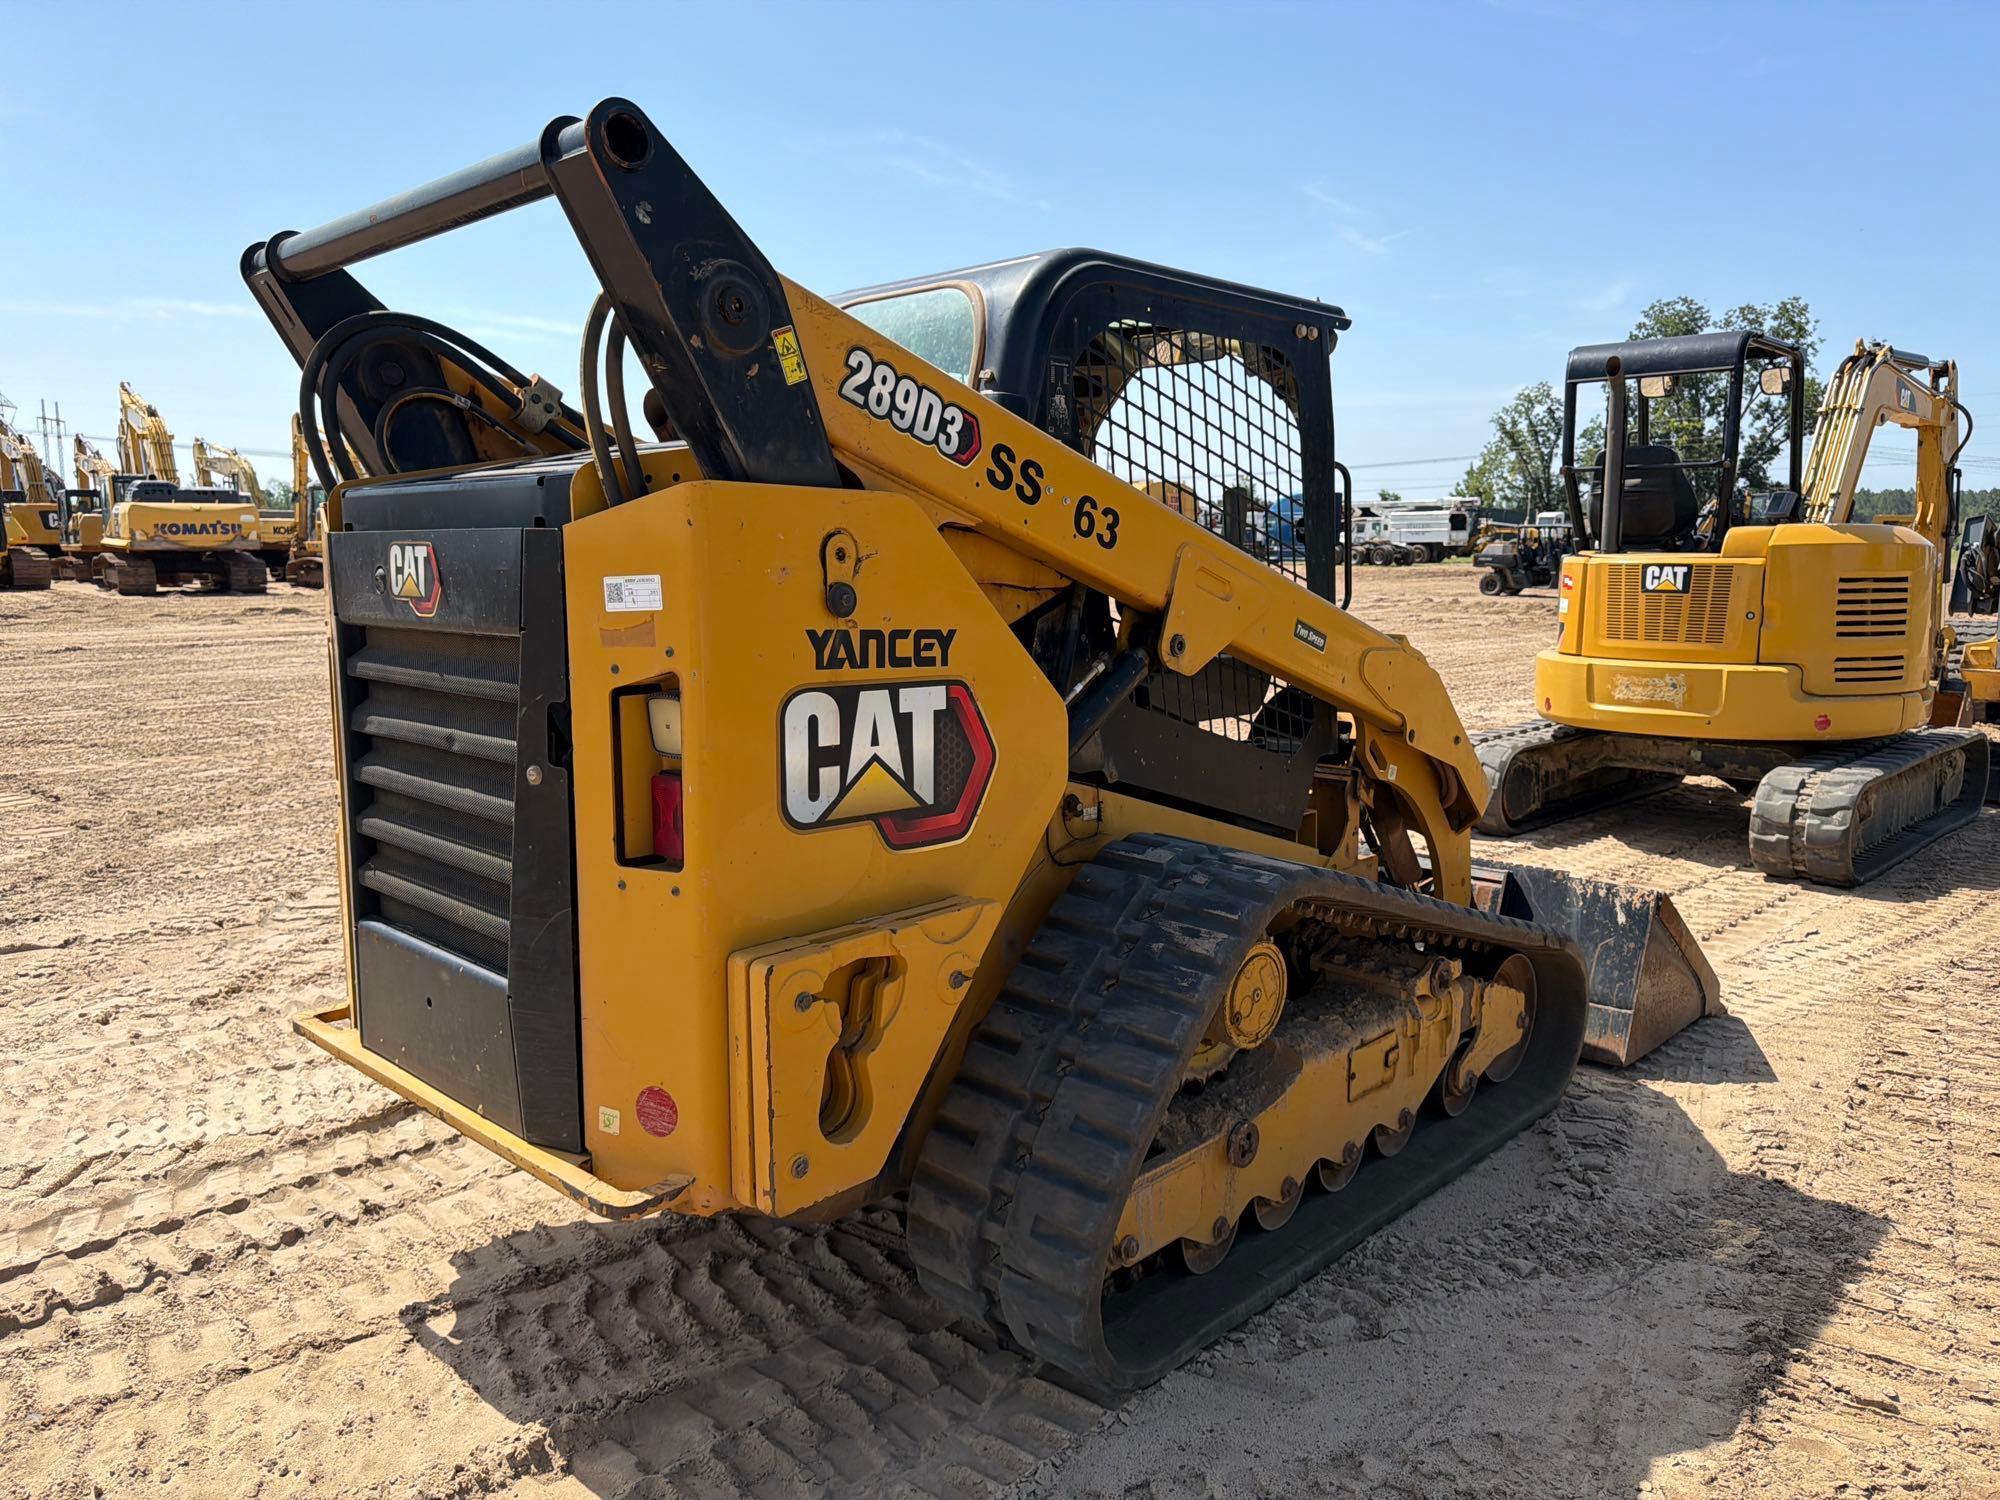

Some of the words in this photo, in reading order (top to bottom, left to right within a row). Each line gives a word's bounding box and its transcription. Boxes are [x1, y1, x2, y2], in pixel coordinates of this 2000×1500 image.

[840, 349, 964, 455] 289D3
[1900, 388, 1911, 409] CAT
[986, 443, 1044, 505] SS
[1074, 495, 1120, 549] 63
[154, 520, 242, 535] KOMATSU
[389, 544, 428, 597] CAT
[1646, 565, 1688, 591] CAT
[805, 629, 957, 670] YANCEY
[784, 685, 947, 824] CAT
